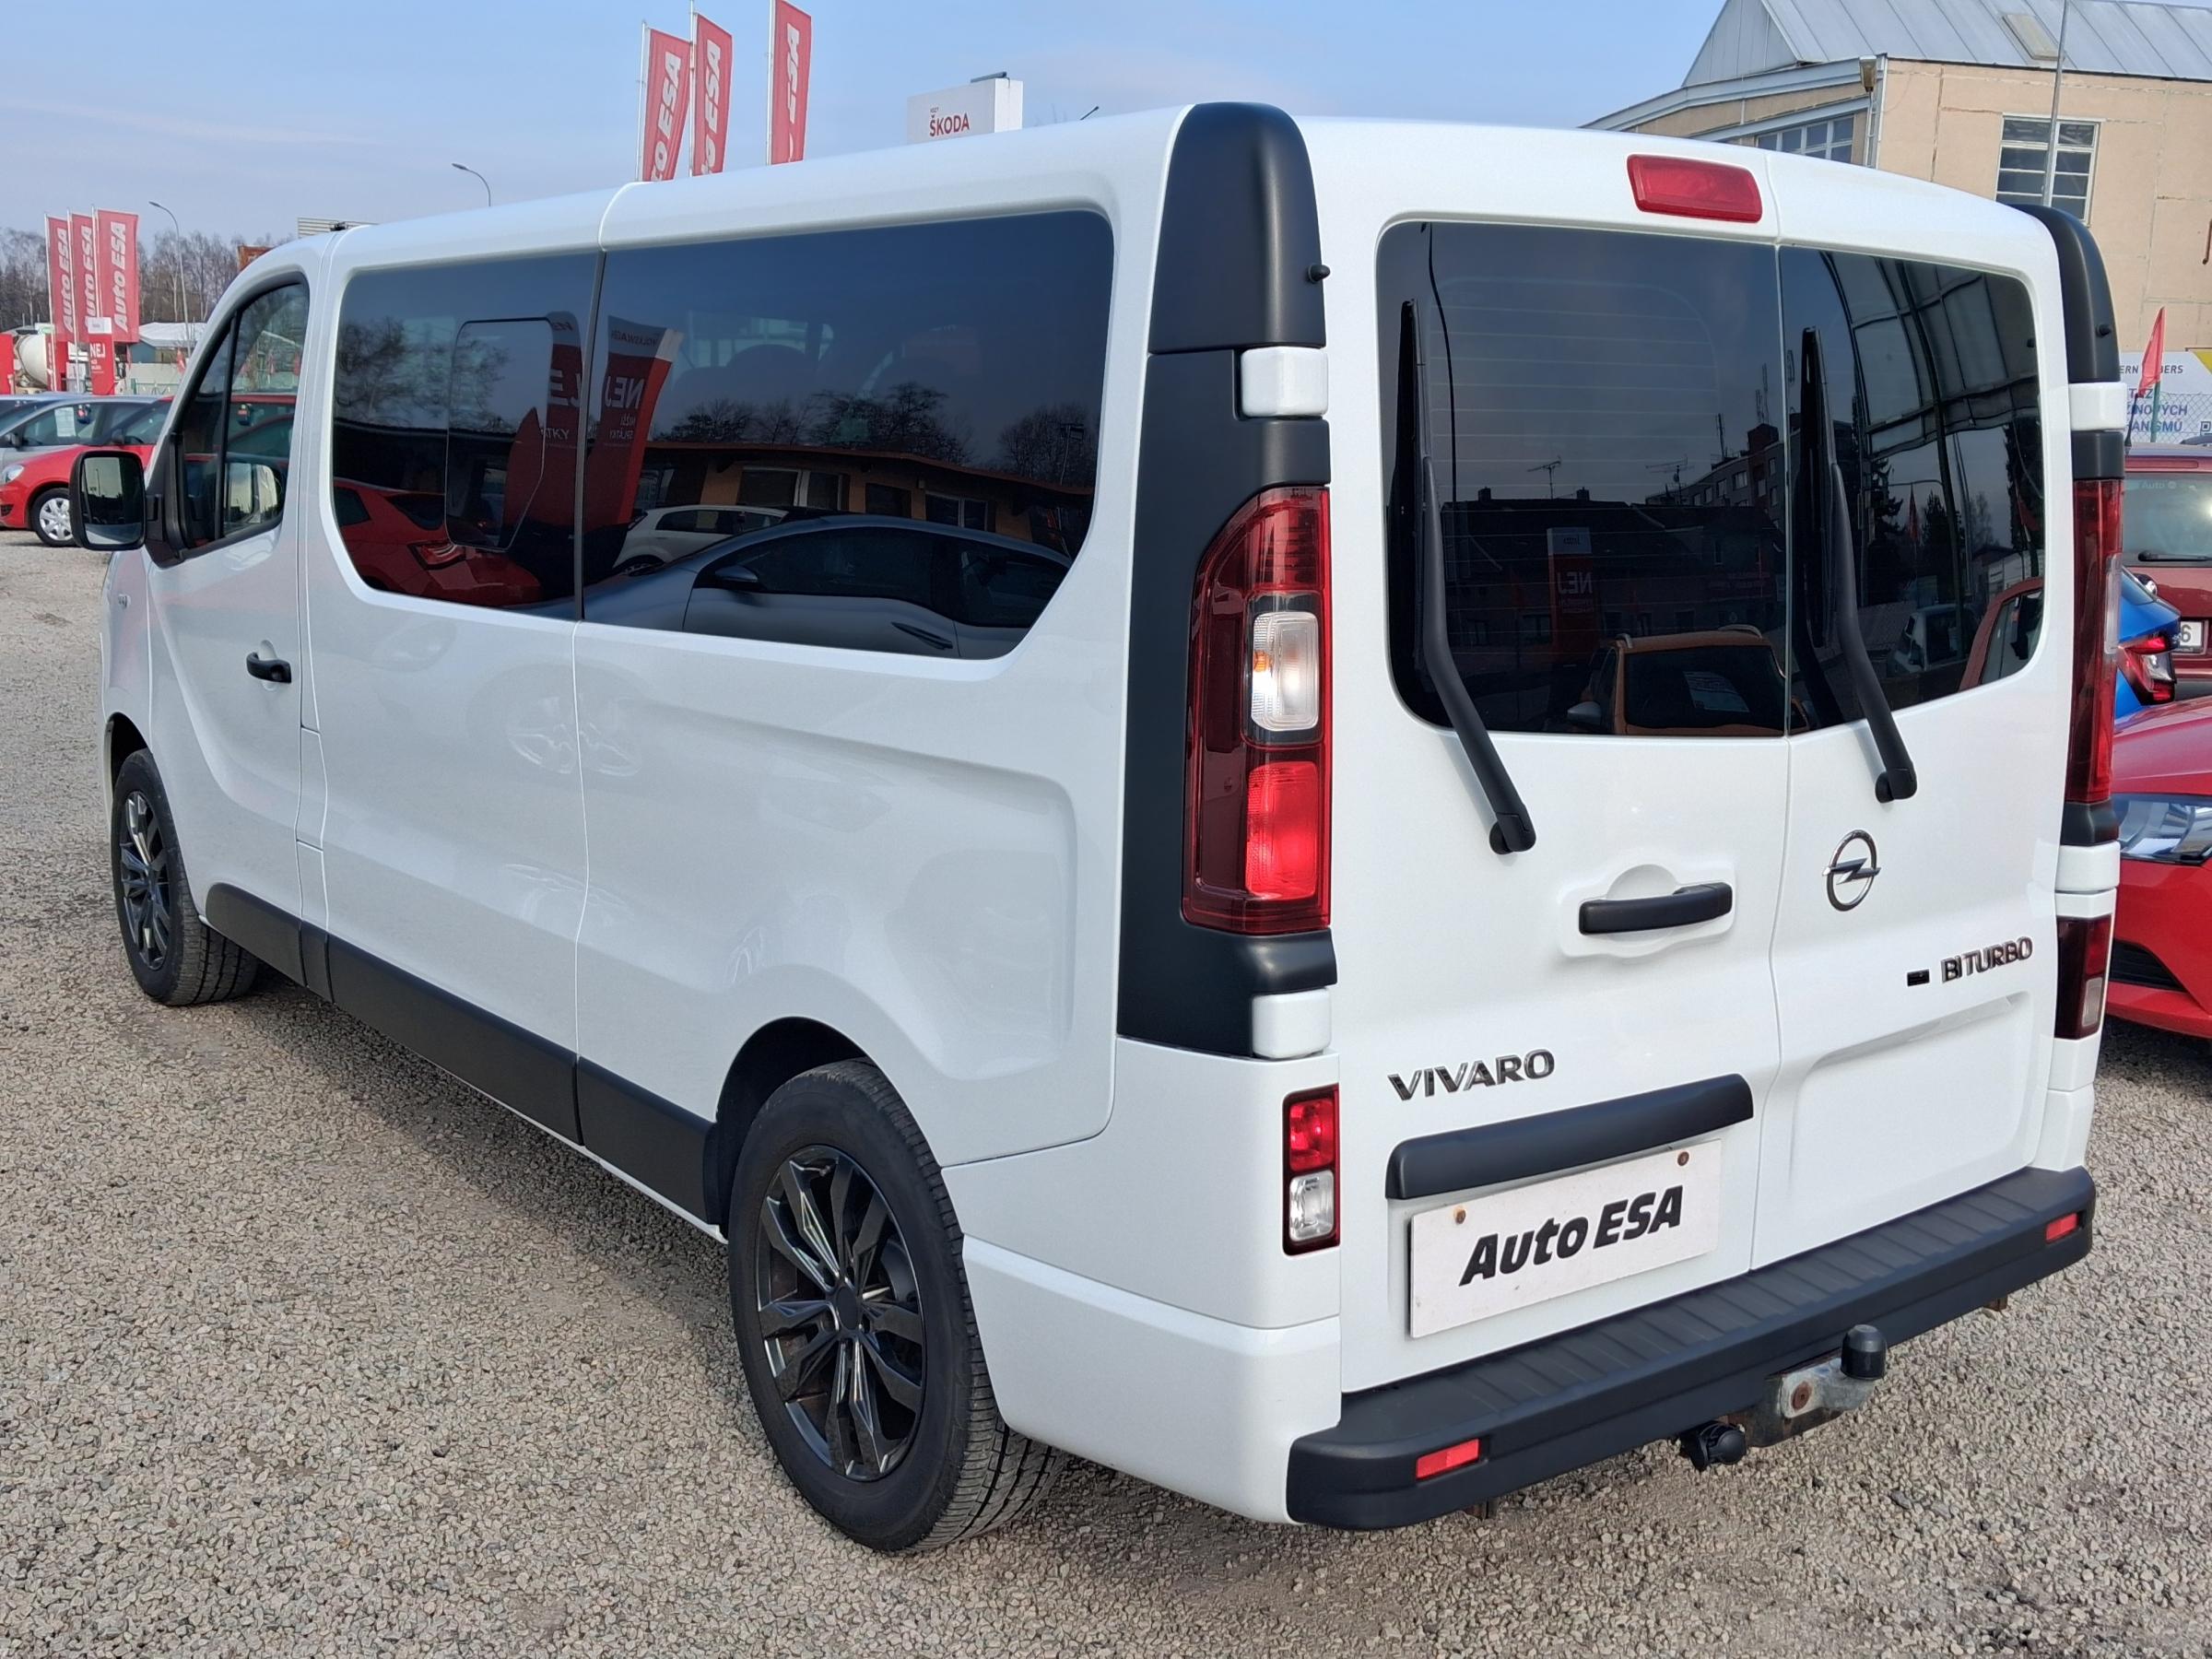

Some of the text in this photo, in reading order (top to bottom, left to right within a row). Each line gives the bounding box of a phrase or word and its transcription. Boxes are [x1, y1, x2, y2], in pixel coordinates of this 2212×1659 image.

[657, 51, 682, 140] ESA
[705, 39, 721, 133] ESA
[929, 112, 970, 136] ŠKODA
[81, 225, 93, 271] ESA
[57, 227, 74, 333] Auto ESA
[111, 221, 128, 333] Auto ESA
[89, 343, 106, 358] NEJ
[2119, 365, 2138, 373] ERN
[1940, 935, 2033, 983] BITURBO
[1387, 1048, 1555, 1100] VIVARO
[1458, 1184, 1683, 1287] Auto ESA
